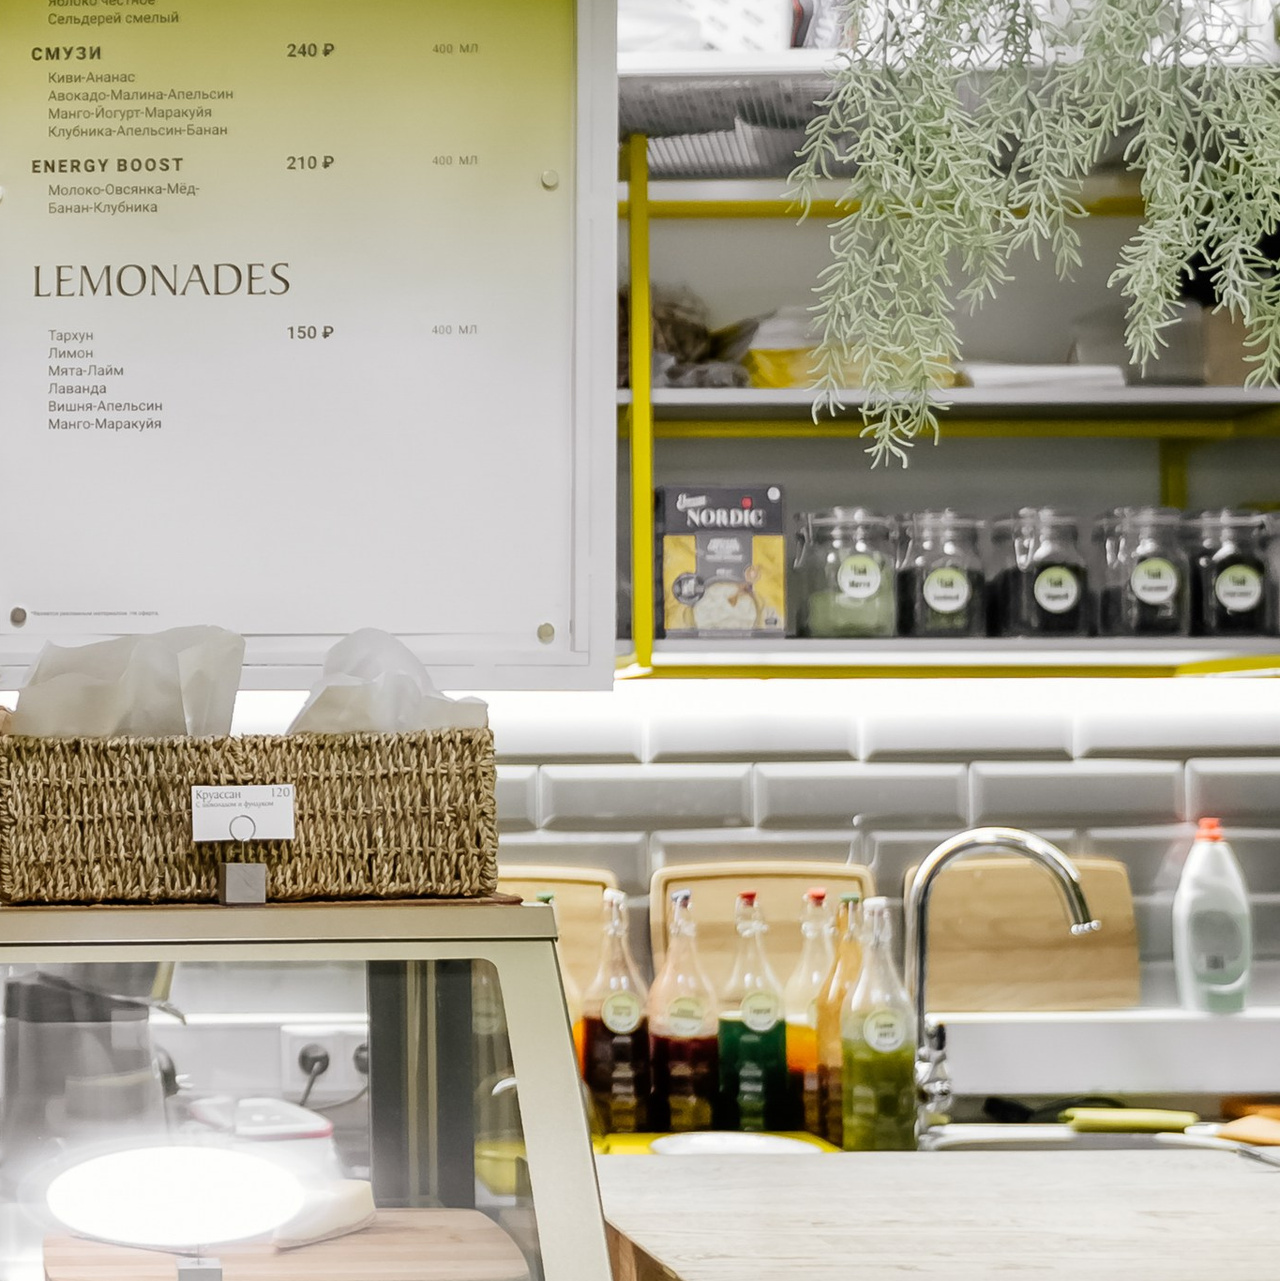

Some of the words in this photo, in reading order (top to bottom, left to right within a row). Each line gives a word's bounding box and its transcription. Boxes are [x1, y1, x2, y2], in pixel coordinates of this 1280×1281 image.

[47, 11, 122, 27] Сельдерей
[125, 10, 180, 24] смелый
[31, 46, 101, 62] СМУЗИ
[286, 42, 318, 58] 240
[48, 71, 136, 84] Киви-Ананас
[47, 88, 234, 103] Авокадо-Малина-Апельсин
[48, 104, 213, 122] Манго-Йогурт-Маракуйя
[48, 123, 228, 141] Клубника-Апельсин-Банан
[31, 158, 109, 174] ENERGY
[116, 157, 184, 173] BOOST
[286, 155, 318, 170] 210
[48, 200, 158, 216] Банан-Клубника
[34, 262, 290, 298] LEMONADES
[48, 329, 94, 344] Тархун
[287, 325, 317, 340] 150
[47, 347, 94, 359] Лимон
[48, 364, 124, 377] Мята-Лайм
[48, 382, 107, 396] Лаванда
[48, 400, 163, 413] Вишня-Апельсин
[48, 417, 162, 433] Манго-Маракуйя
[687, 509, 763, 527] NORDIC
[196, 790, 241, 802] Круассан
[271, 788, 290, 797] 120
